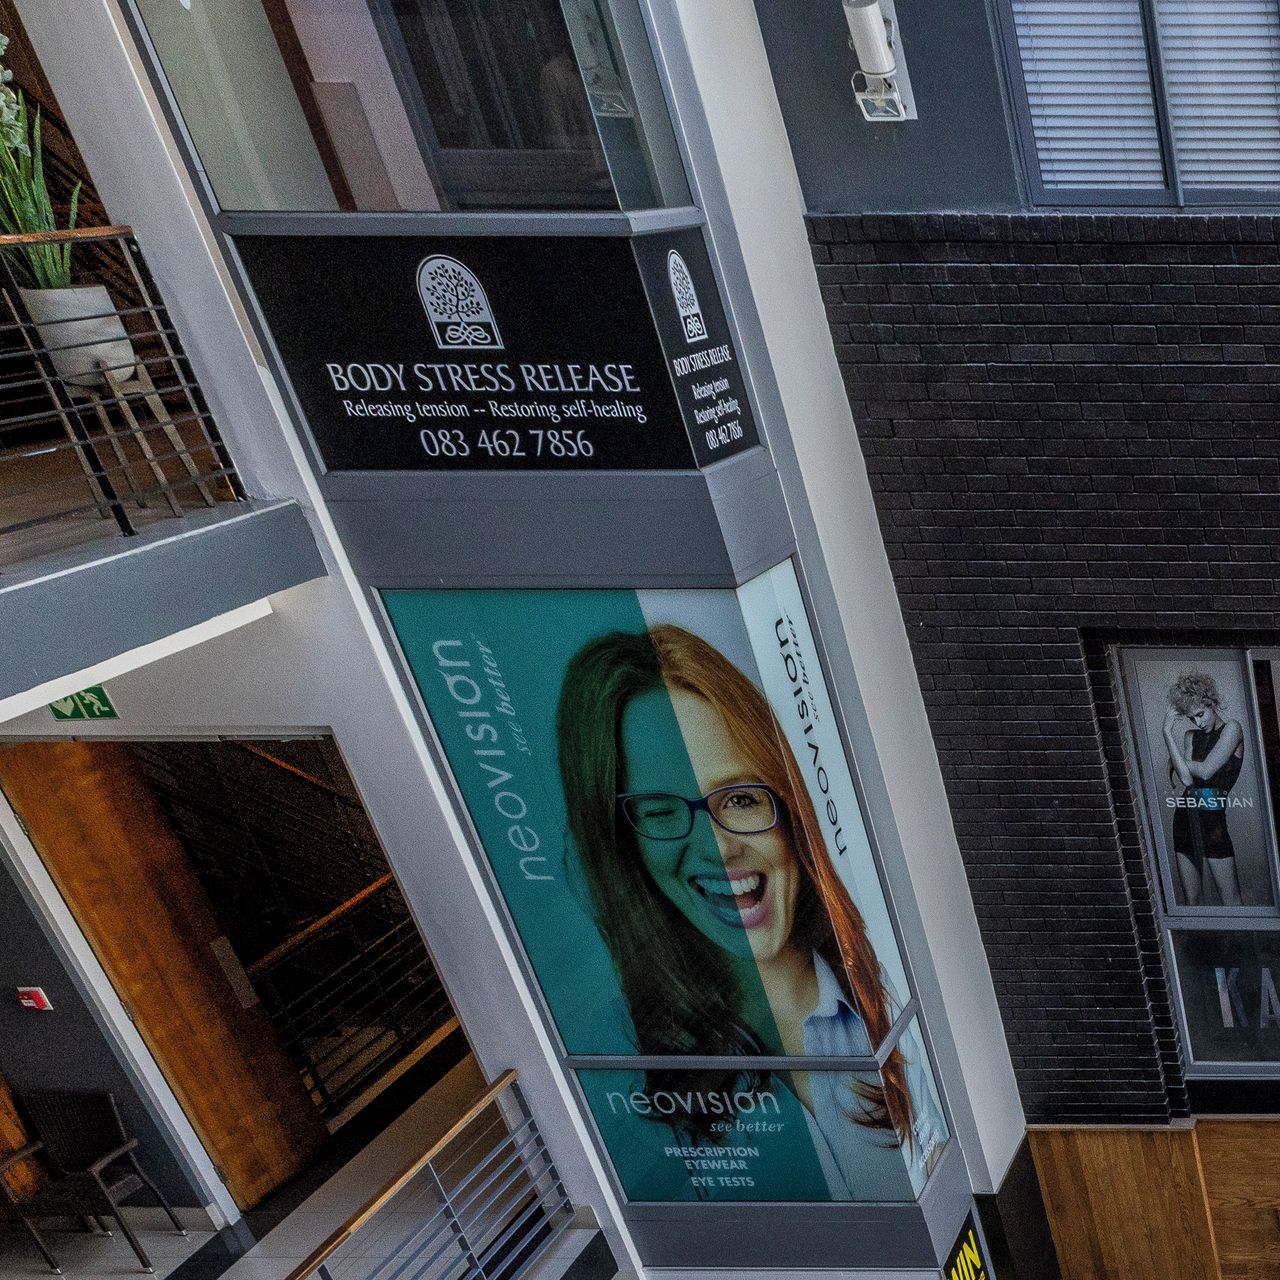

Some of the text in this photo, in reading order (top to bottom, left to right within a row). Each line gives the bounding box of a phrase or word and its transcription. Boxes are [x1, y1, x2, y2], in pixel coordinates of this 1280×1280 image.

[673, 344, 732, 377] BODY STRESS RELEASE
[326, 363, 641, 392] BODY STRESS RELEASE
[343, 400, 416, 423] Releasing
[415, 401, 470, 417] tension
[491, 401, 560, 423] Restoring
[563, 400, 647, 423] self-healing
[420, 430, 593, 457] 083 462 7856
[705, 429, 719, 450] 083
[473, 640, 532, 757] see better
[774, 617, 848, 856] neovision
[432, 636, 554, 883] neovision
[1165, 797, 1253, 808] SEBASTIAN
[606, 1091, 781, 1115] neovision
[709, 1119, 785, 1132] see better
[664, 1146, 760, 1157] PRESCRIPTION
[685, 1160, 749, 1170] EYEWEAR
[691, 1176, 755, 1187] EYE TESTS
